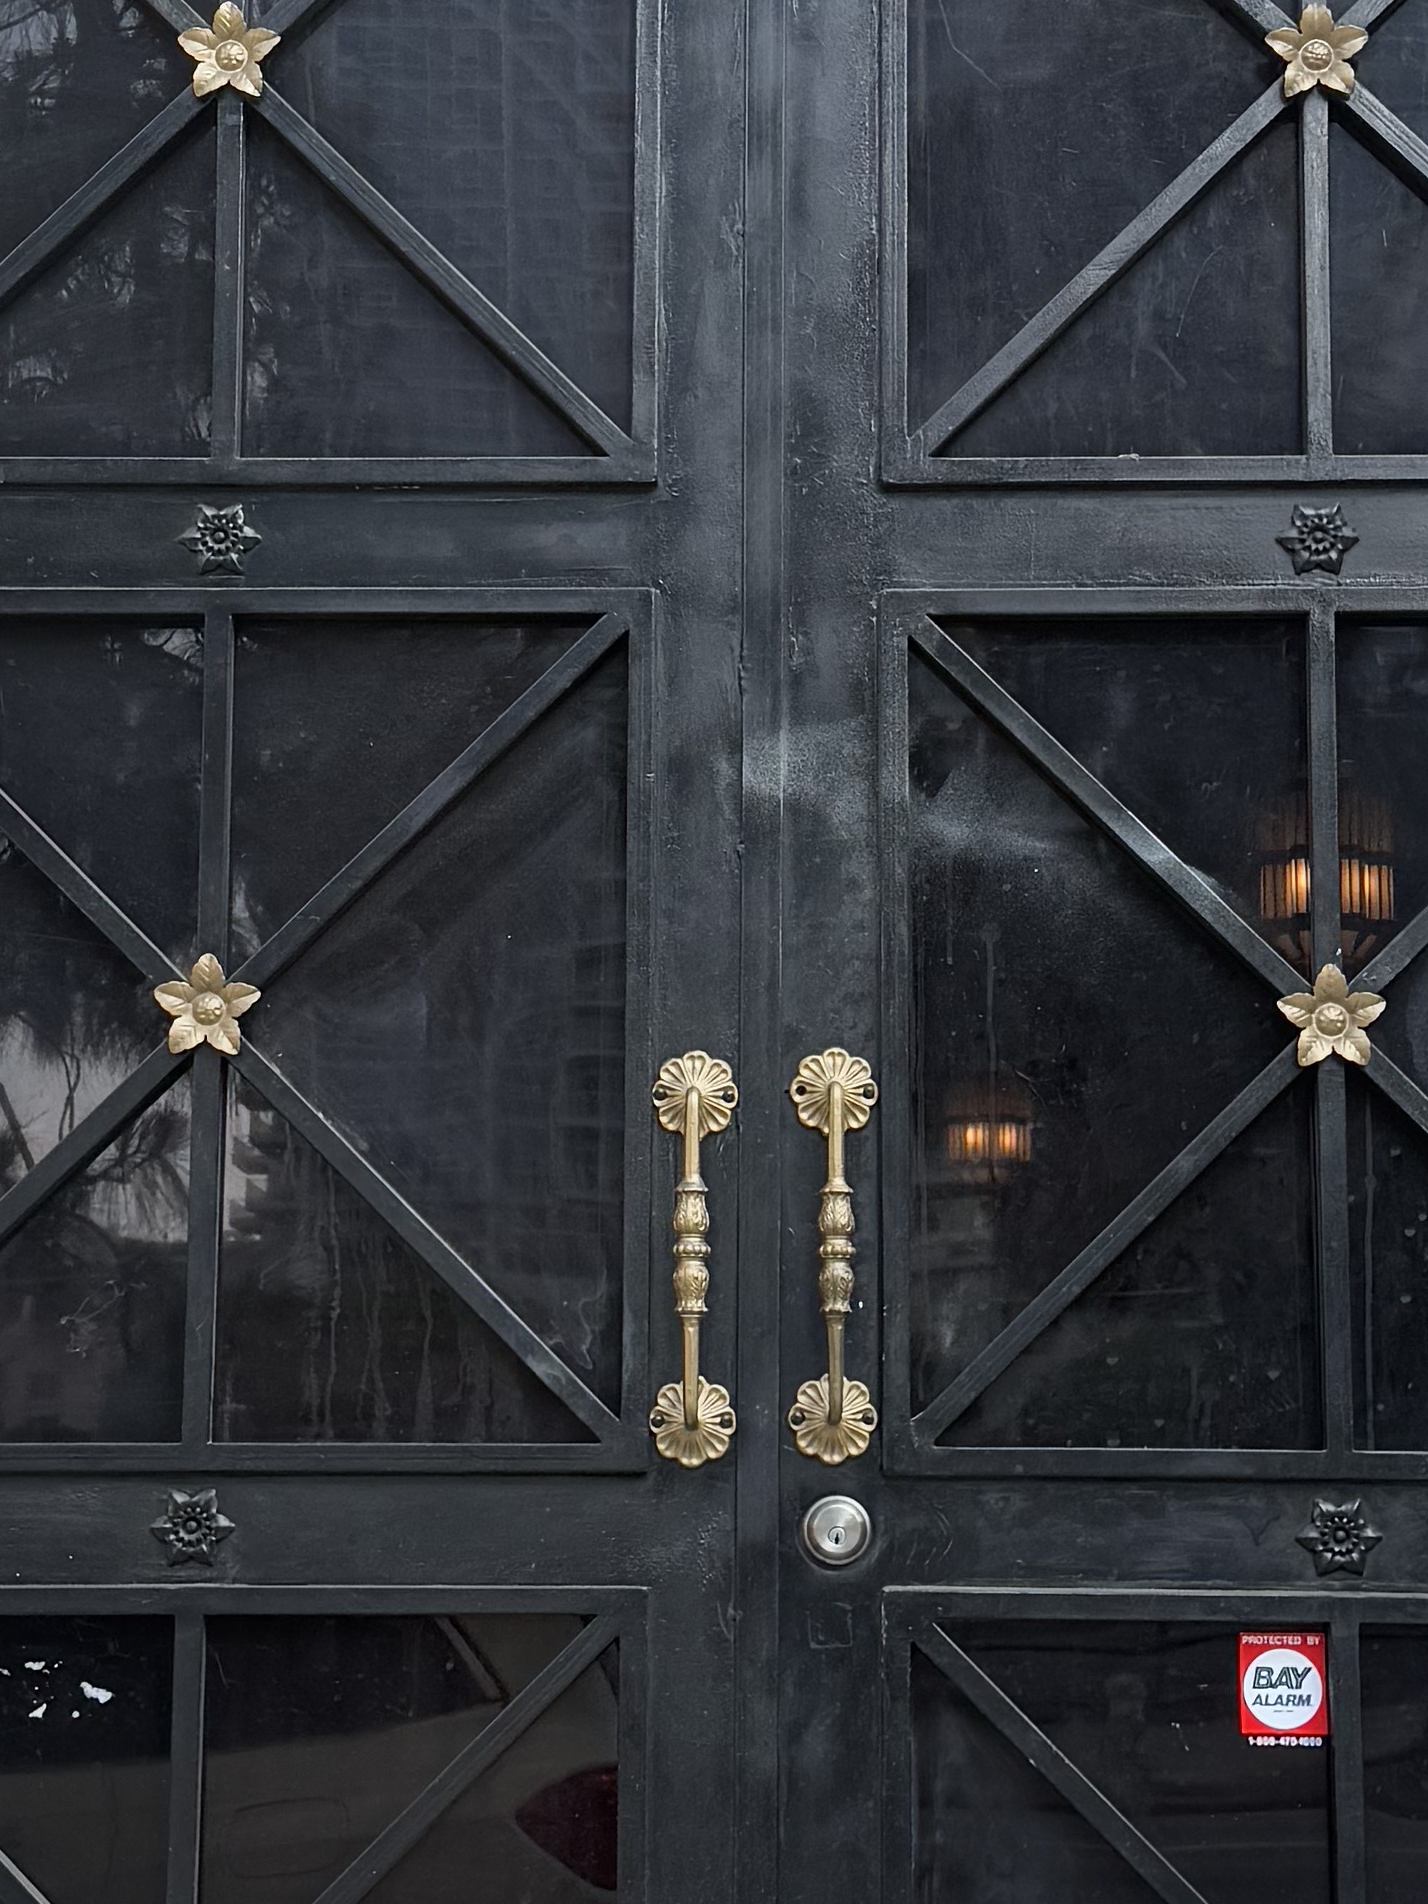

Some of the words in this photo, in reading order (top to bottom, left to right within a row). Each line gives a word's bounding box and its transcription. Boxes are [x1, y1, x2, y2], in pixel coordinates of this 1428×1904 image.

[1241, 1635, 1302, 1645] PROTECTED
[1307, 1635, 1321, 1645] BY
[1252, 1666, 1313, 1689] BAY
[1252, 1694, 1313, 1706] ALARM
